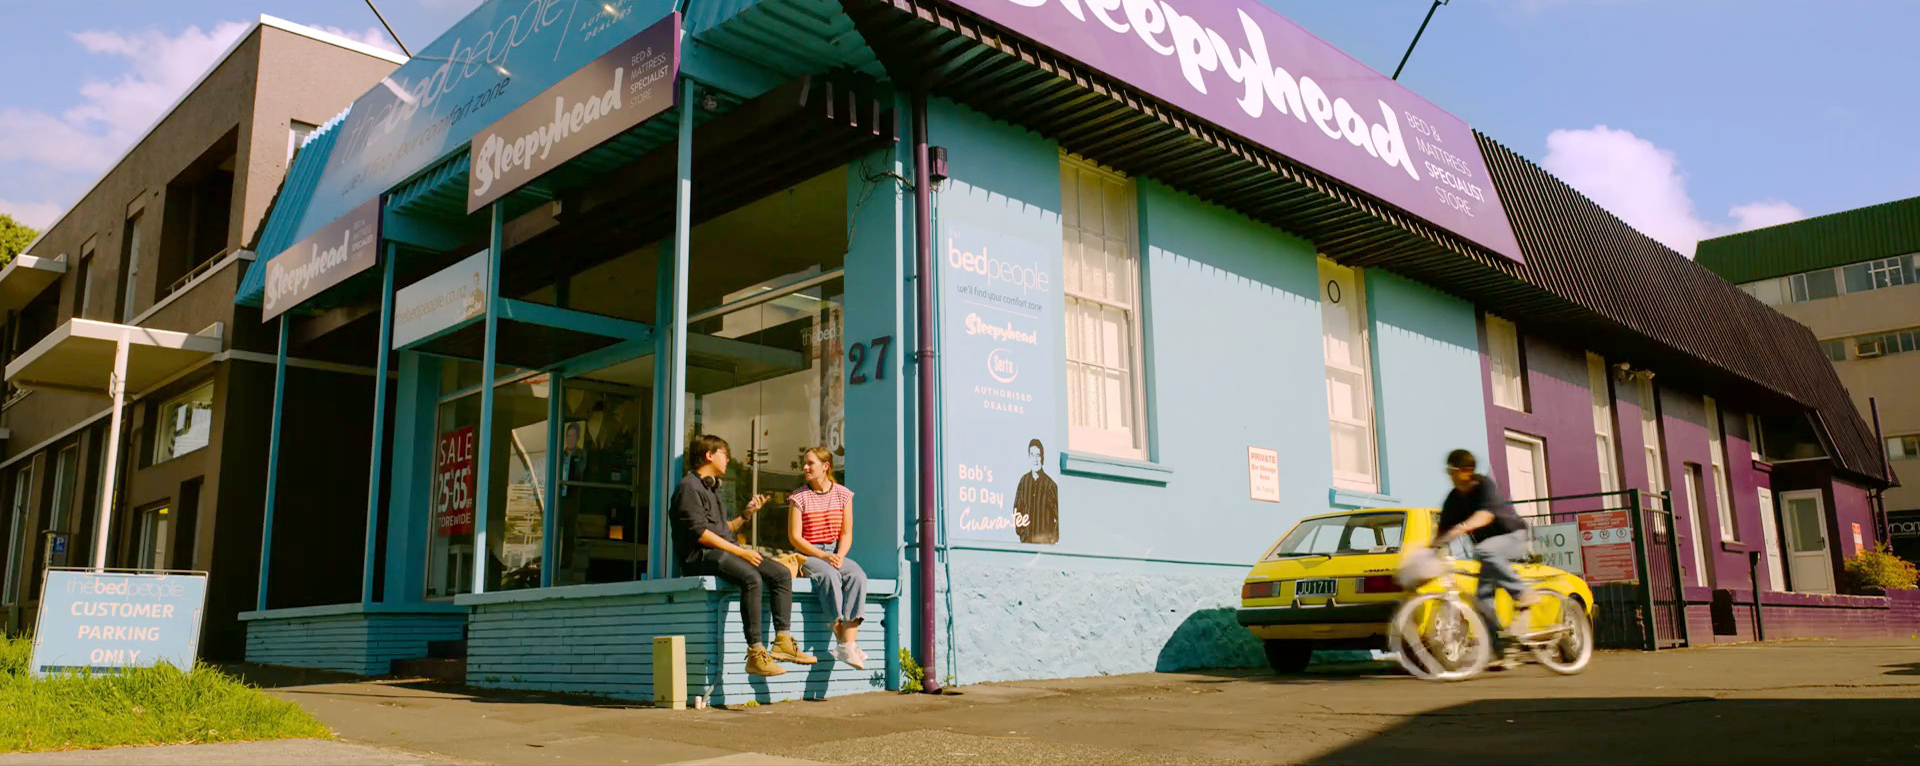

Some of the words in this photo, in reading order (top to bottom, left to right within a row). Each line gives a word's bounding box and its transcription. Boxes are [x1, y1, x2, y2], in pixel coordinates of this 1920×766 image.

[630, 52, 666, 80] MATTRESS
[631, 50, 645, 67] BED
[645, 46, 652, 58] &
[630, 65, 669, 94] SPECIALIST
[472, 76, 511, 114] zone
[630, 88, 653, 109] STORE
[474, 67, 624, 197] Sleepyhead
[1404, 110, 1430, 136] BED
[1430, 125, 1442, 143] &
[1416, 136, 1472, 178] MATTRESS
[1424, 160, 1485, 203] SPECIALIST
[1434, 186, 1474, 217] STORE
[266, 230, 350, 310] Sleepyhead
[948, 237, 1049, 295] bedpeople
[957, 285, 973, 295] we'll
[973, 286, 987, 299] find
[987, 292, 1003, 302] your
[1002, 295, 1026, 308] comfort
[1028, 302, 1043, 311] zone
[965, 312, 1038, 346] Sleepyhead
[848, 335, 892, 387] 27
[994, 354, 1013, 374] Serta
[974, 385, 1032, 403] AUTHORISED
[983, 399, 1024, 415] DEALERS
[439, 432, 473, 467] SALE
[1250, 452, 1276, 464] PRIVATE
[958, 463, 993, 483] Bob's
[959, 486, 977, 503] 60
[980, 487, 1004, 509] Day
[959, 506, 1031, 532] Guarantee
[1540, 533, 1565, 549] NO
[66, 577, 184, 601] thebedpeople
[70, 601, 175, 619] CUSTOMER
[77, 624, 160, 641] PARKING
[90, 648, 141, 664] ONLY
